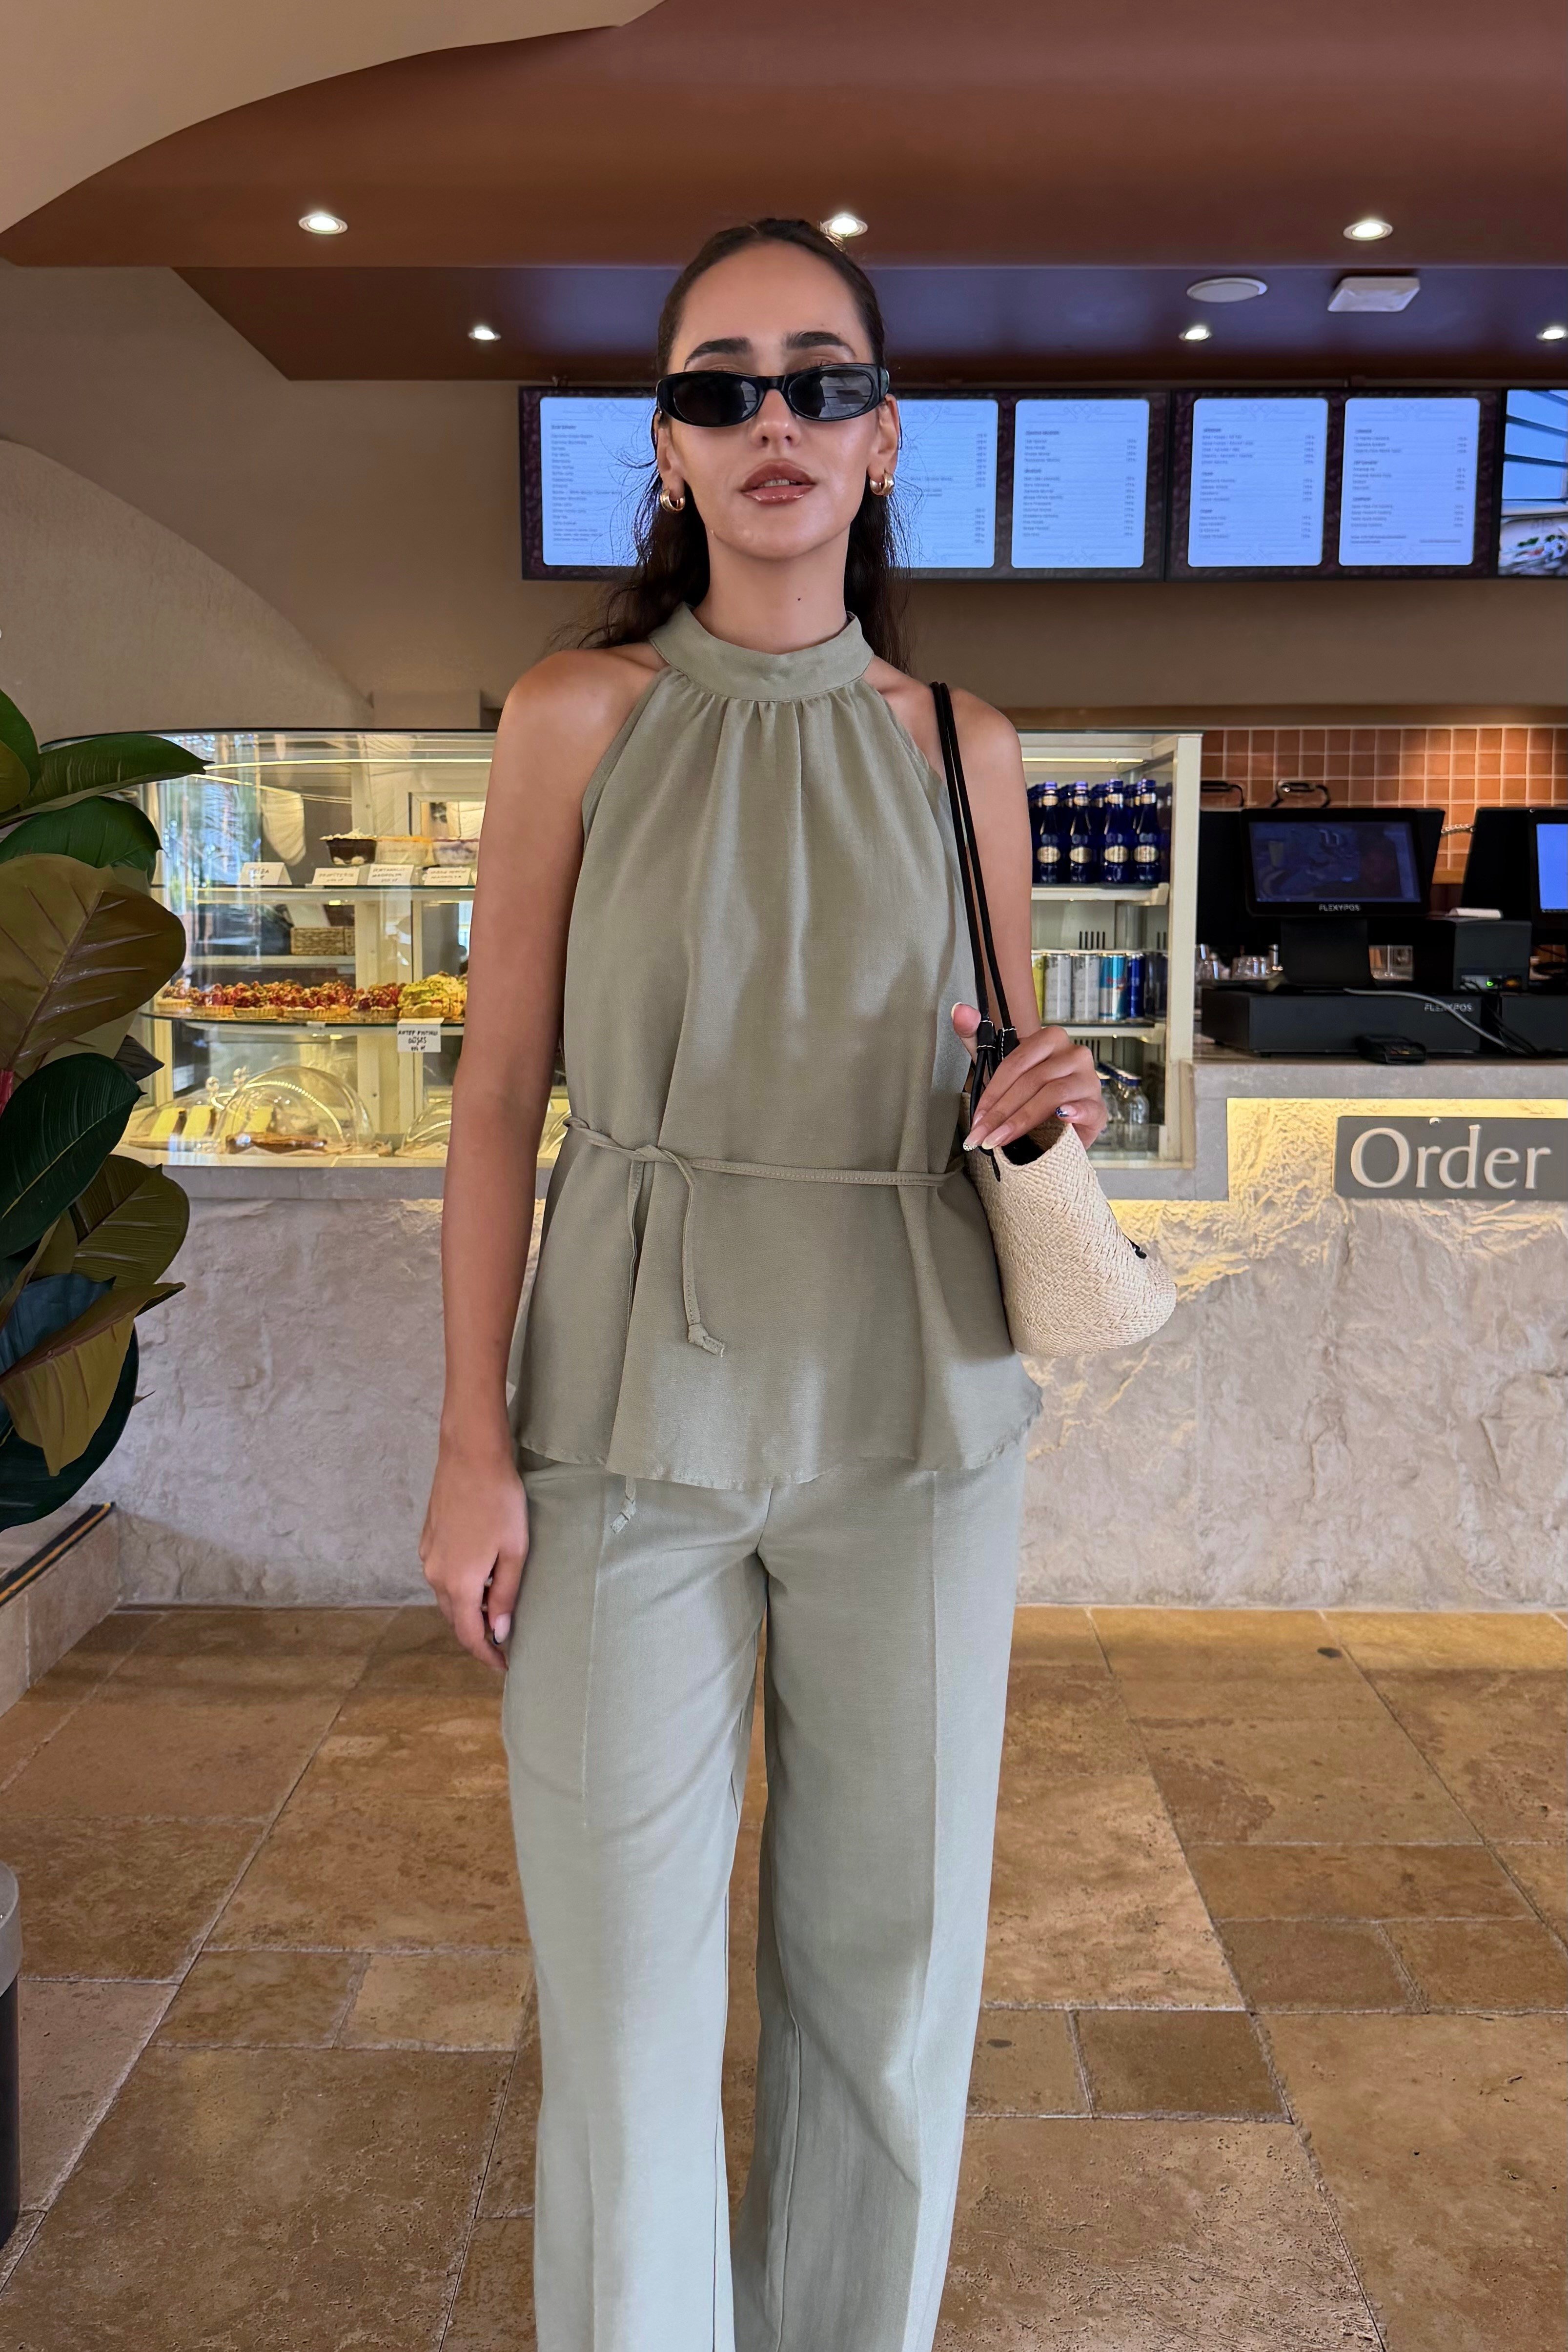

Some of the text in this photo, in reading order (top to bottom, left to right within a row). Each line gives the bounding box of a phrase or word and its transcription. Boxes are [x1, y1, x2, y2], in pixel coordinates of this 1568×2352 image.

[1319, 903, 1361, 912] FLEXYPOS
[1425, 1002, 1473, 1012] FLEPOS
[1350, 1124, 1551, 1189] Order
